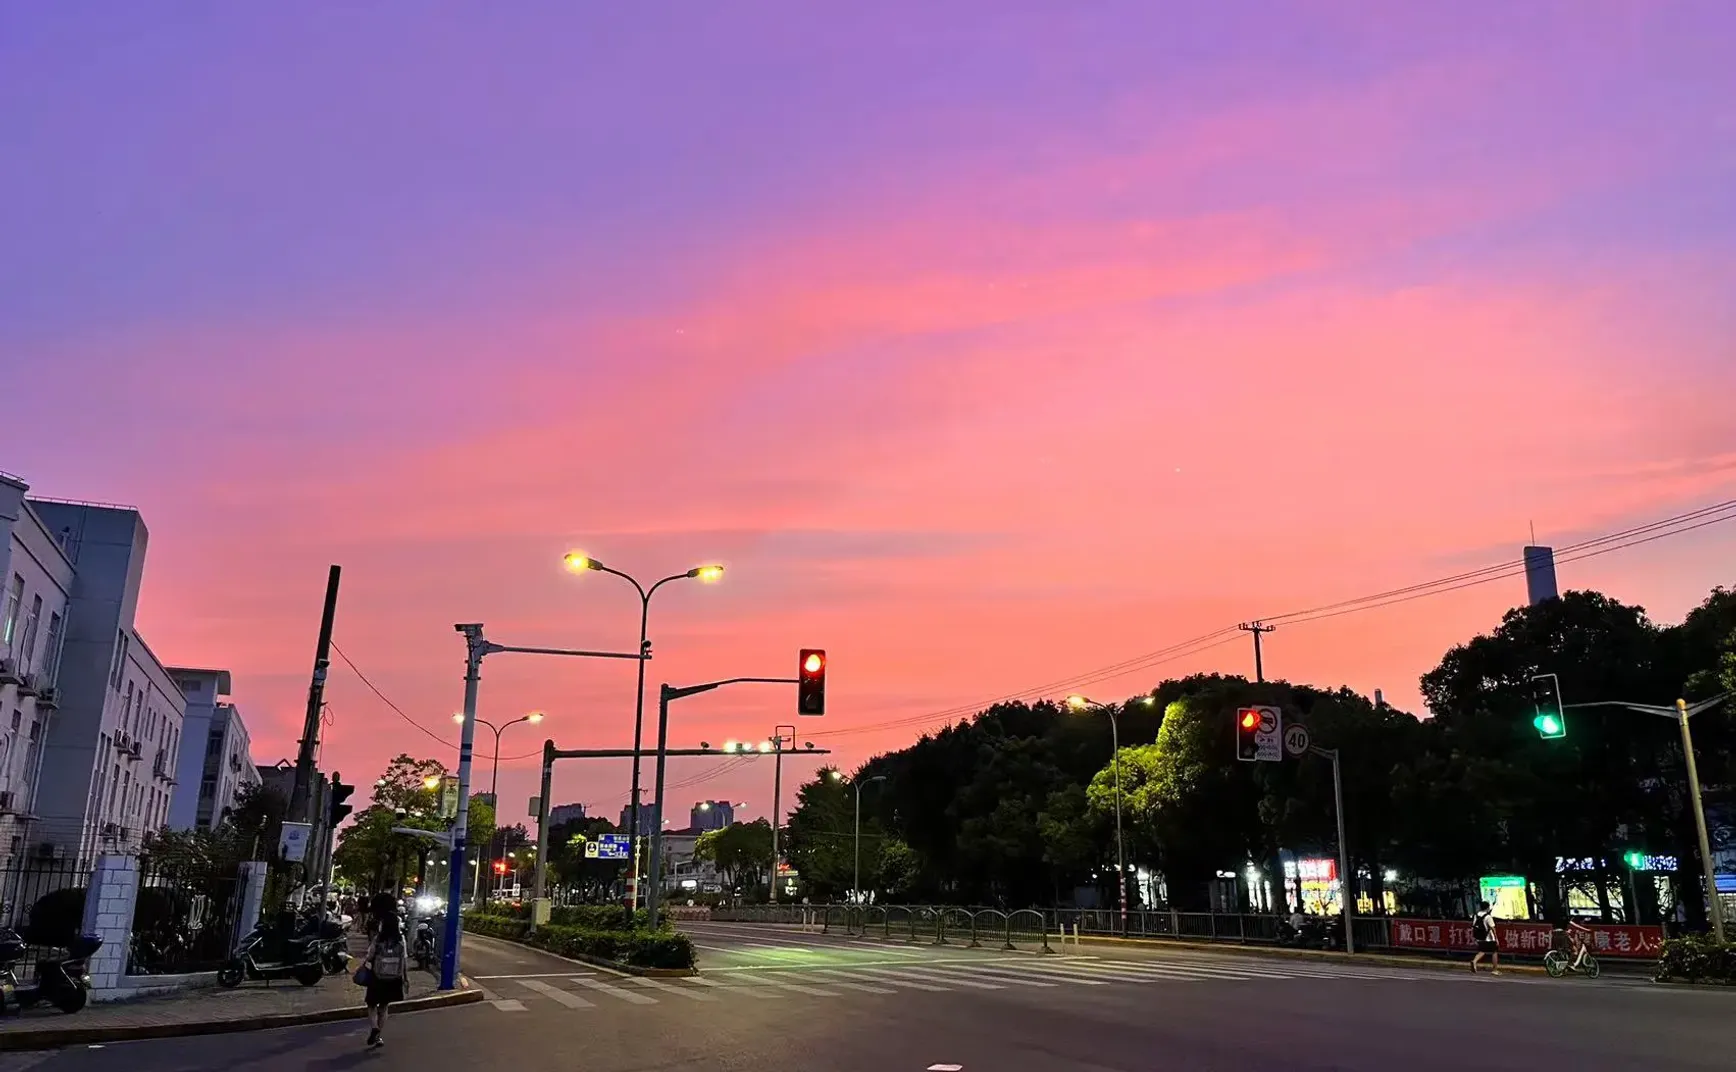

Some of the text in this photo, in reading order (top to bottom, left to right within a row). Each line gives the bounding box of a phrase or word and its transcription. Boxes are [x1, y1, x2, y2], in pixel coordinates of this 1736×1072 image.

[1288, 732, 1306, 748] 40
[1399, 924, 1441, 944] 戴口罩
[1504, 929, 1651, 952] 做新时健康老人
